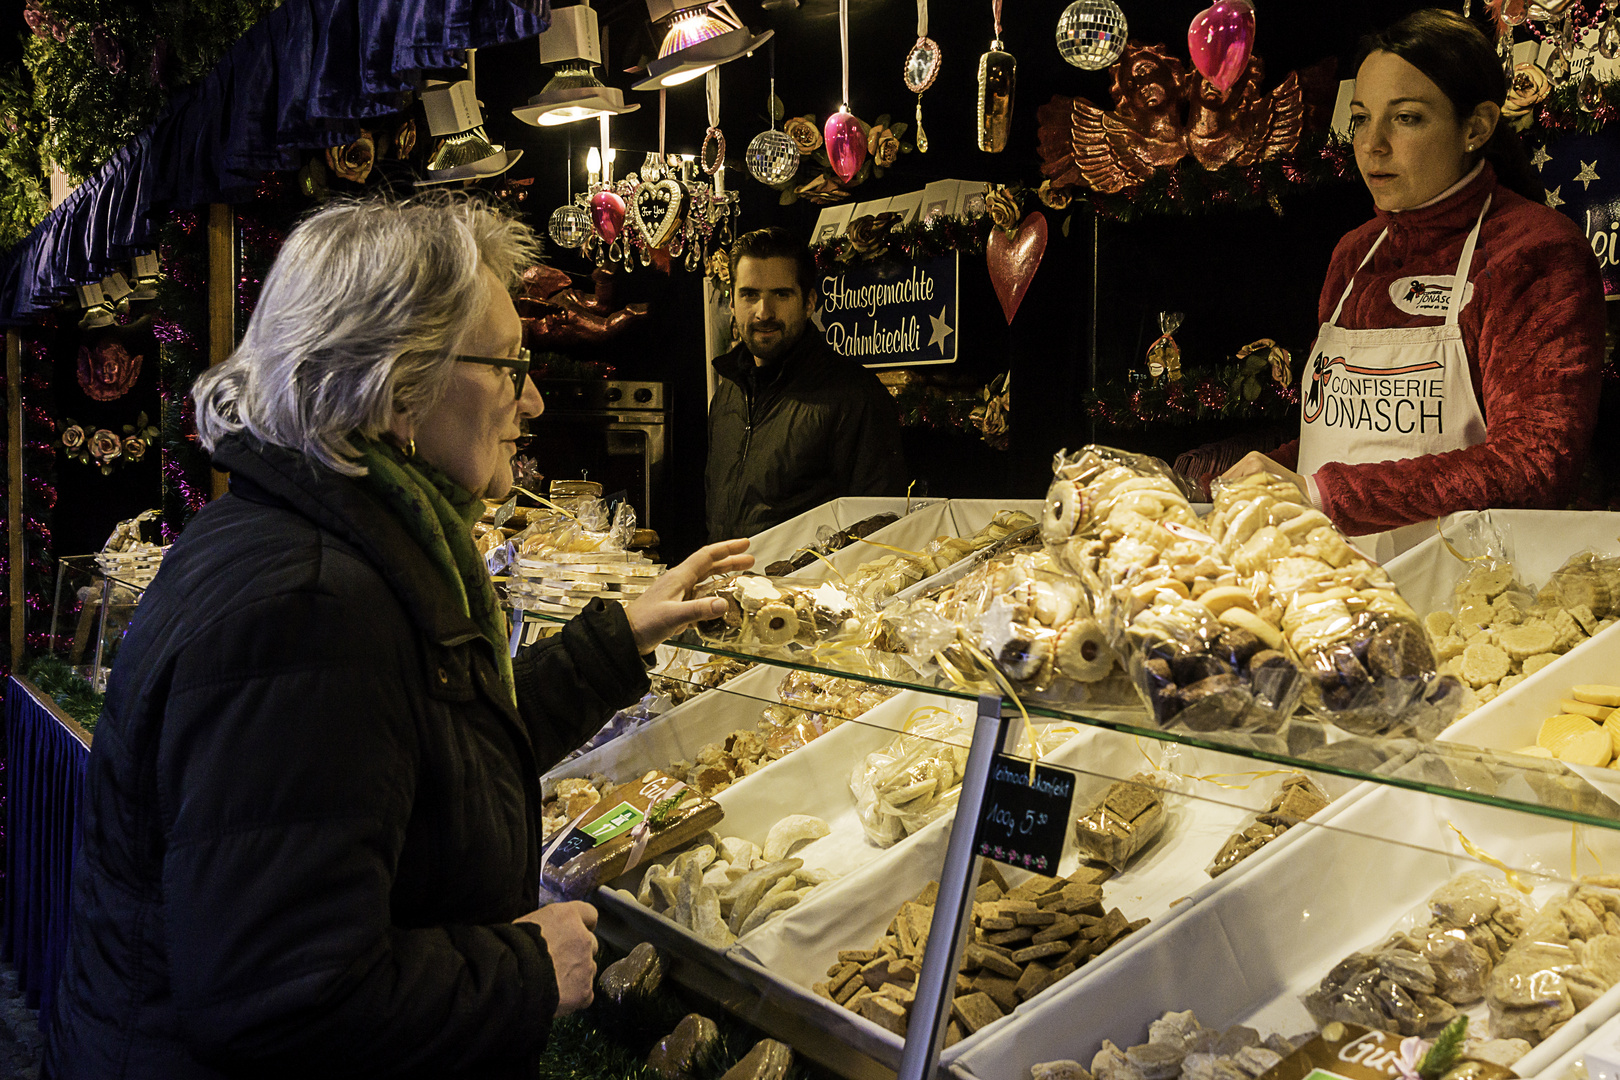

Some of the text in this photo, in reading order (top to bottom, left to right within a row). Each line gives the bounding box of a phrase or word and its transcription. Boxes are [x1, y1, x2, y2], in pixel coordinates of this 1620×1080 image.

[641, 205, 665, 219] For You
[822, 265, 934, 317] Hausgemachte
[1417, 294, 1450, 305] JONASC
[825, 315, 921, 357] Rahmkiechli
[1332, 376, 1444, 398] CONFISERIE
